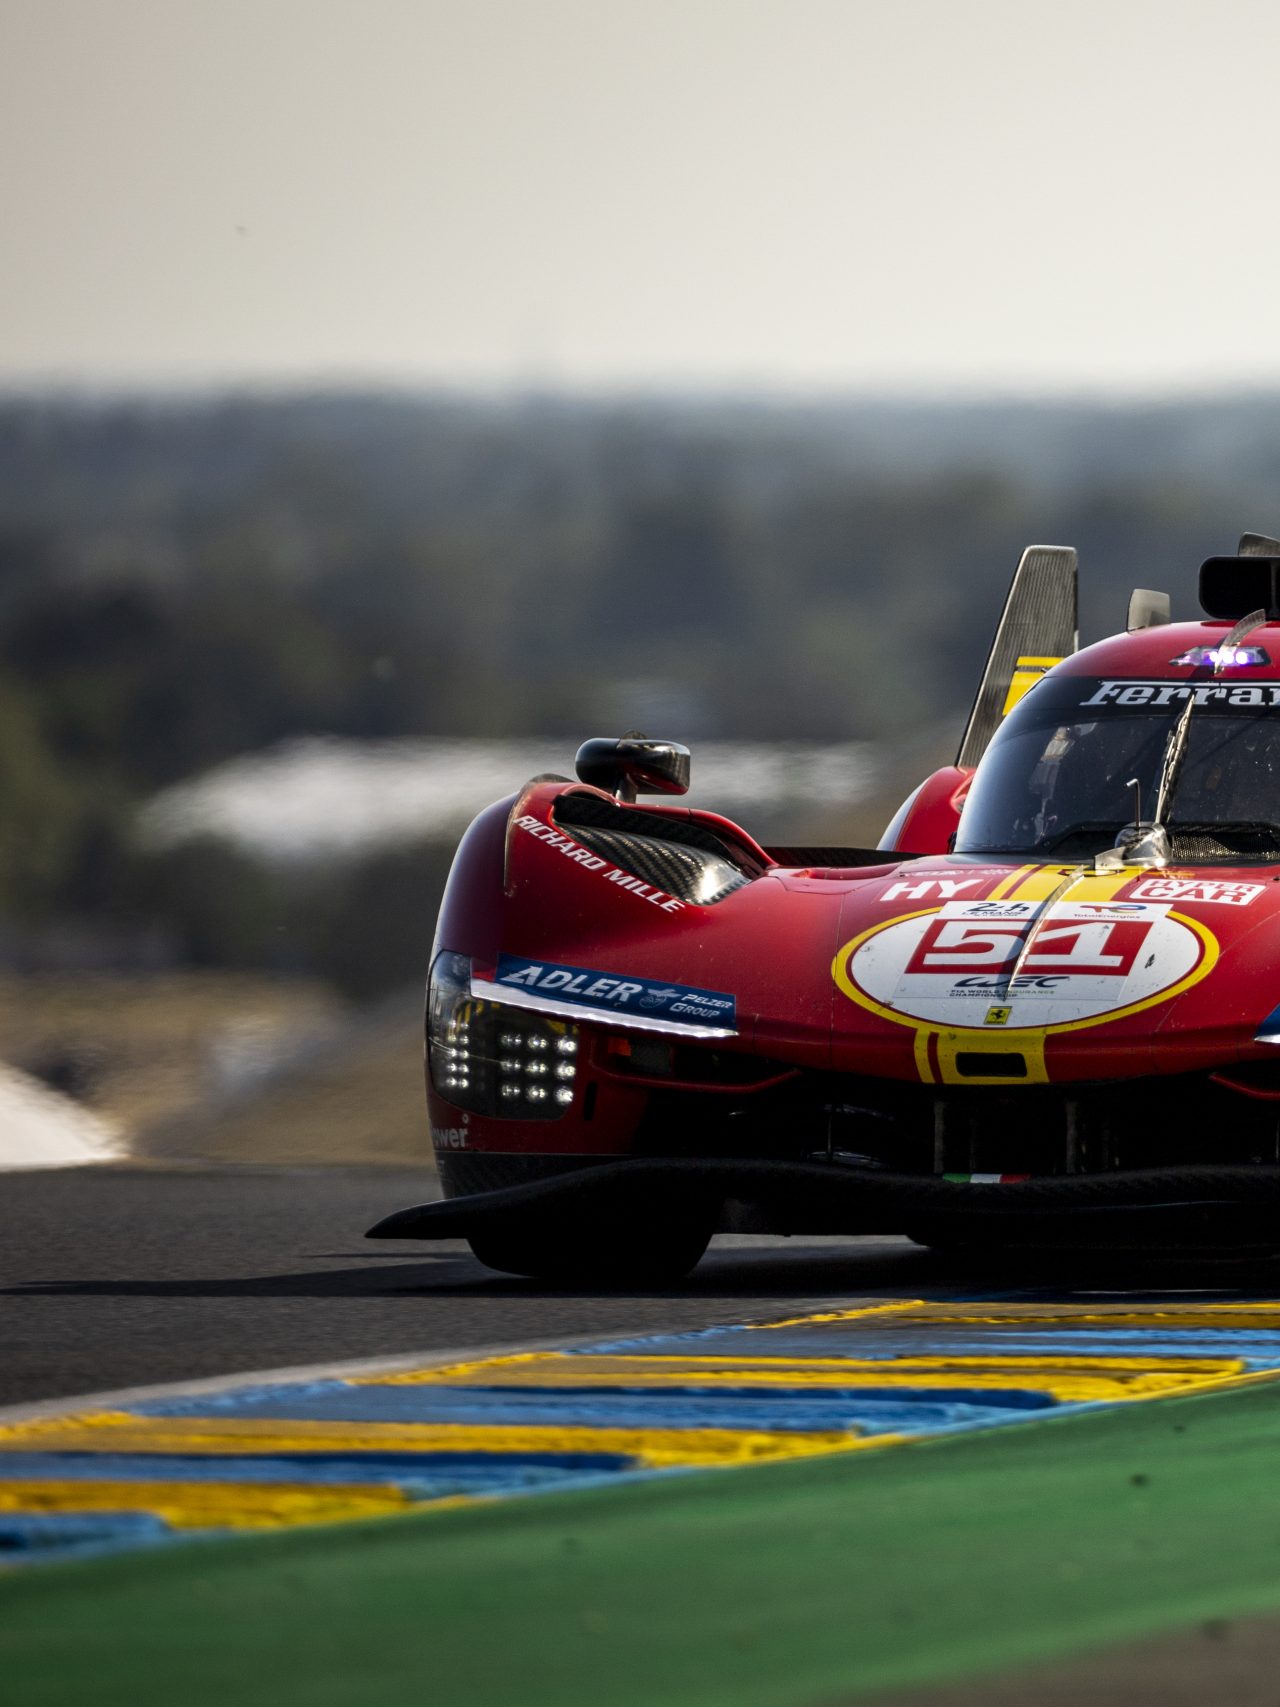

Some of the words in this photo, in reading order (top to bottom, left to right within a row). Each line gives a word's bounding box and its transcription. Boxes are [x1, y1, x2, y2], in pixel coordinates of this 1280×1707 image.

[514, 815, 608, 871] RICHARD
[603, 869, 686, 912] MILLE
[880, 879, 985, 901] HY
[1140, 886, 1248, 903] CAR
[1150, 880, 1256, 892] HYPER
[923, 920, 1124, 967] 51
[500, 965, 643, 1002] ADLER
[954, 976, 1070, 988] WEC
[670, 1002, 721, 1018] GROUP
